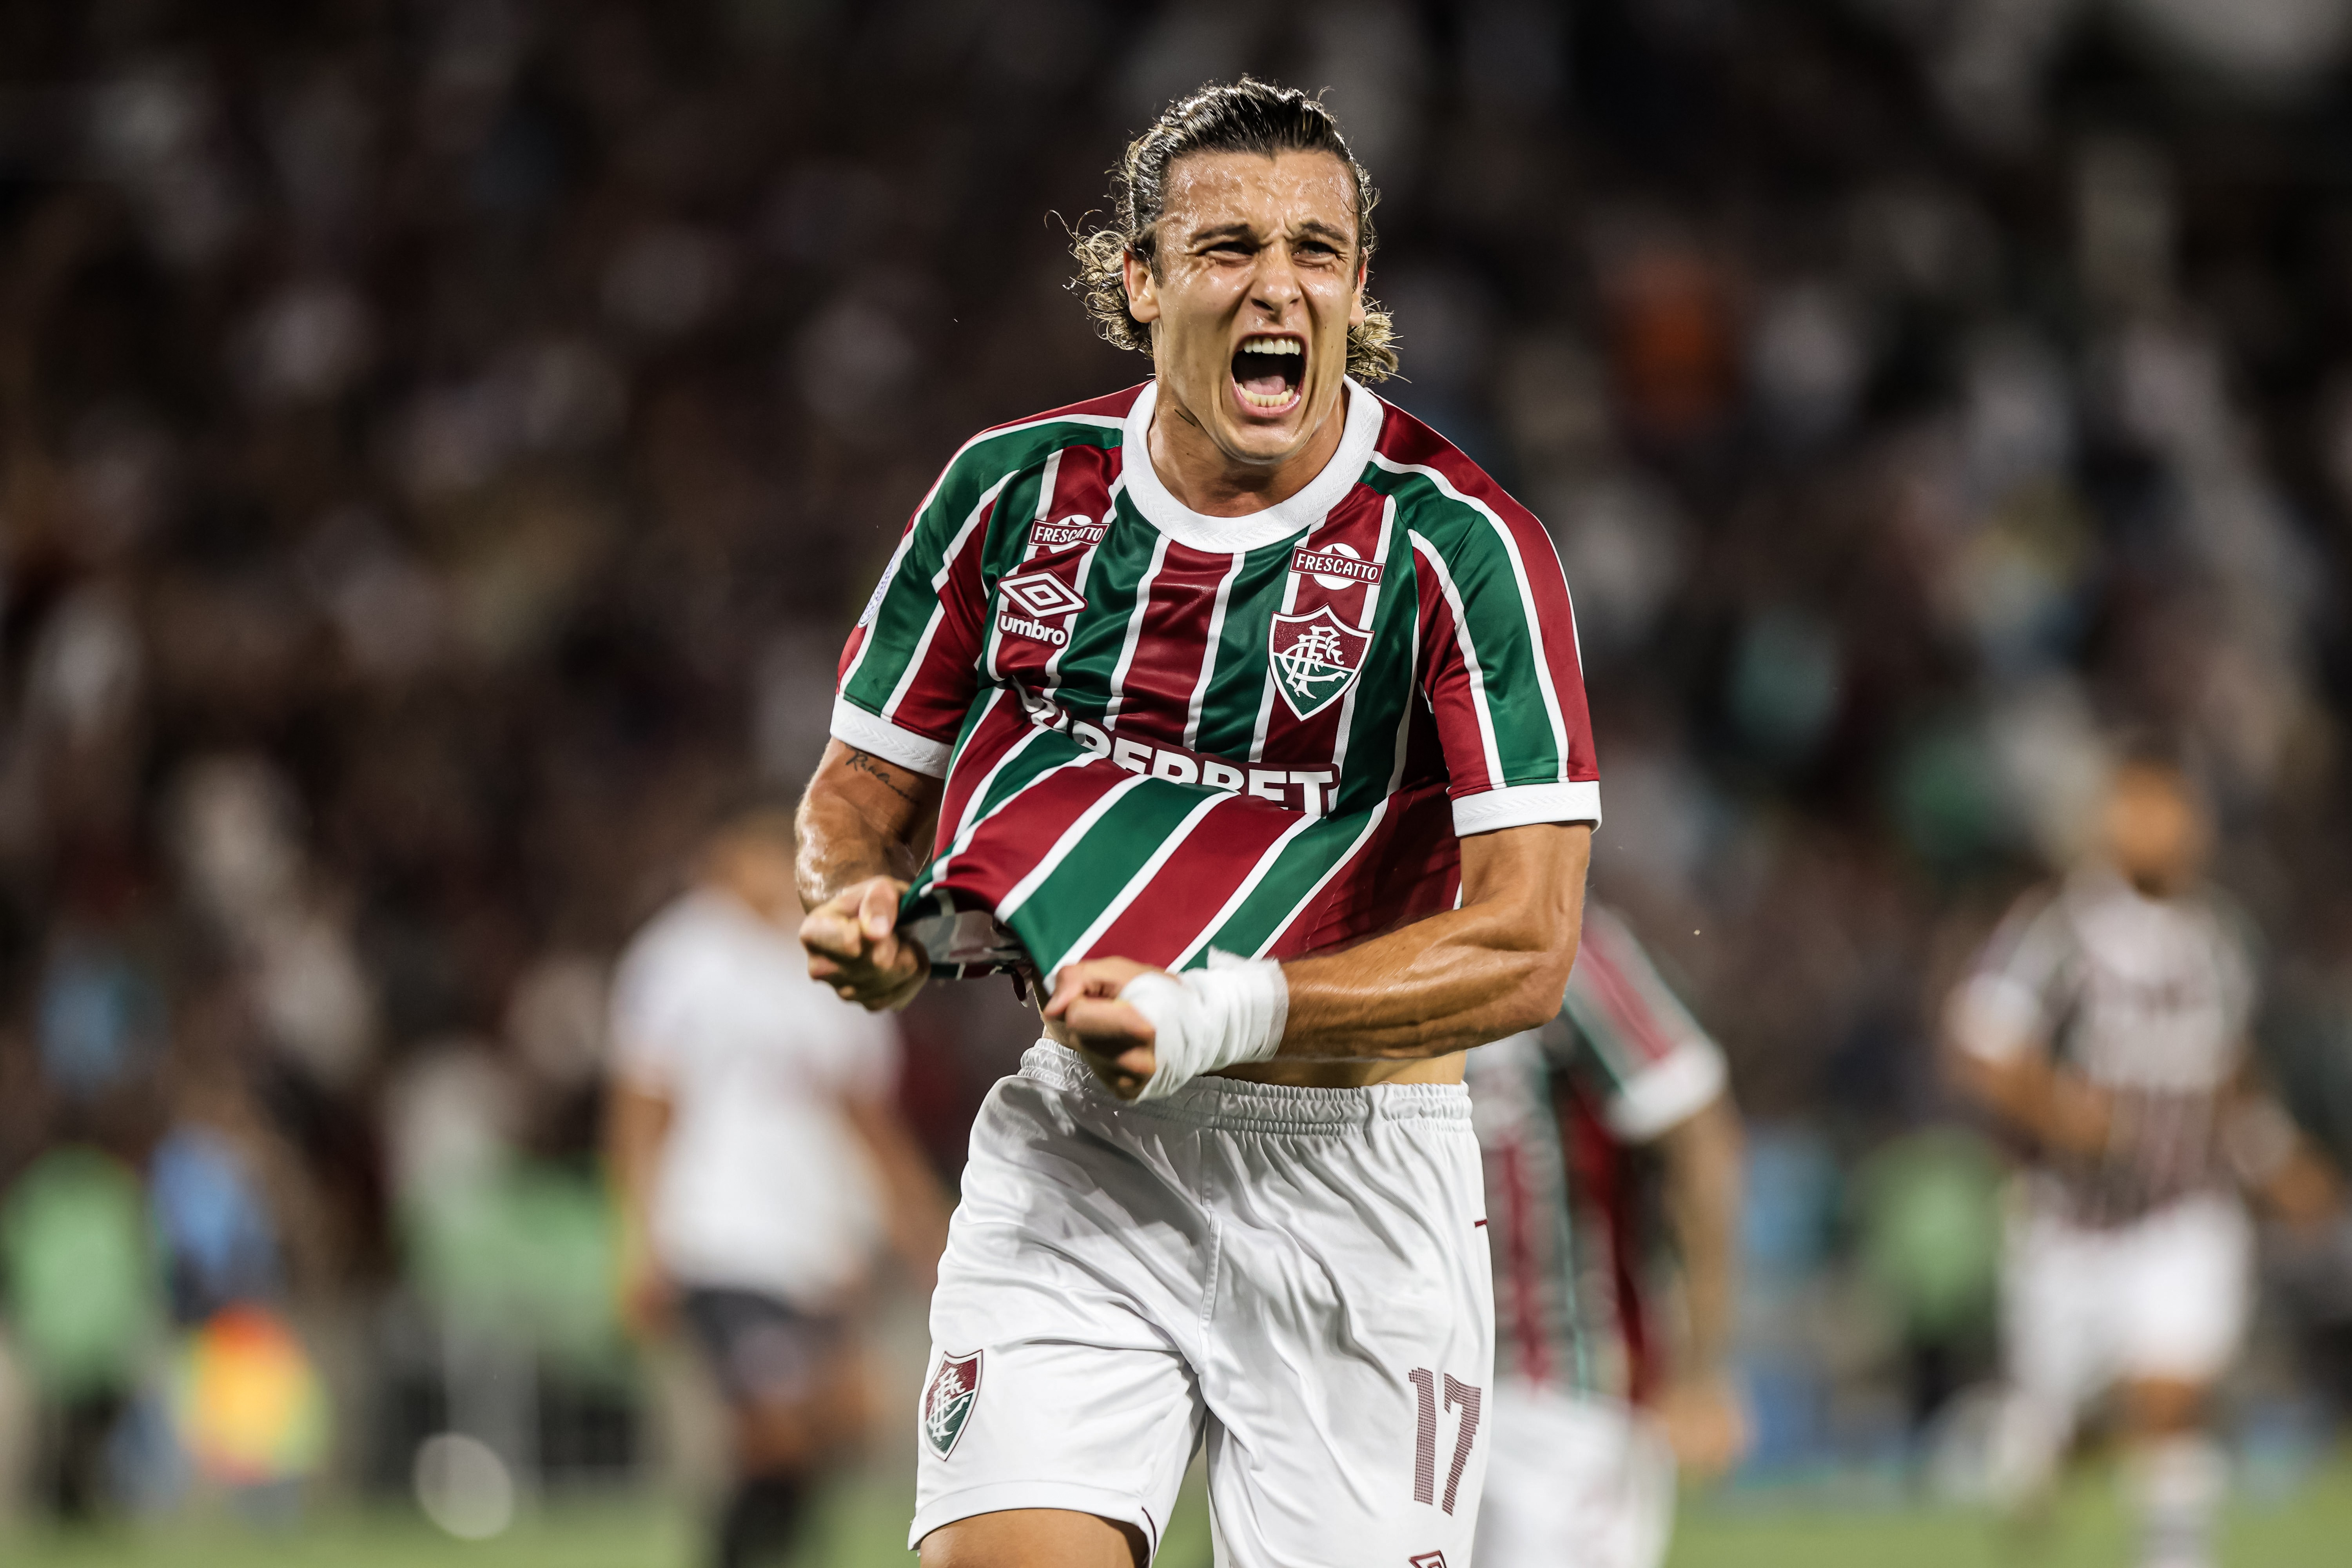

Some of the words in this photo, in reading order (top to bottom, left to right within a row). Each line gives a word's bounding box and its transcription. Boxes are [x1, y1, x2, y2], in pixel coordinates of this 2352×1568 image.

[1034, 526, 1104, 543] FRESCATTO
[1295, 552, 1379, 581] FRESCATTO
[1000, 614, 1066, 646] umbro
[1024, 695, 1333, 817] PERBET
[1408, 1367, 1481, 1517] 17
